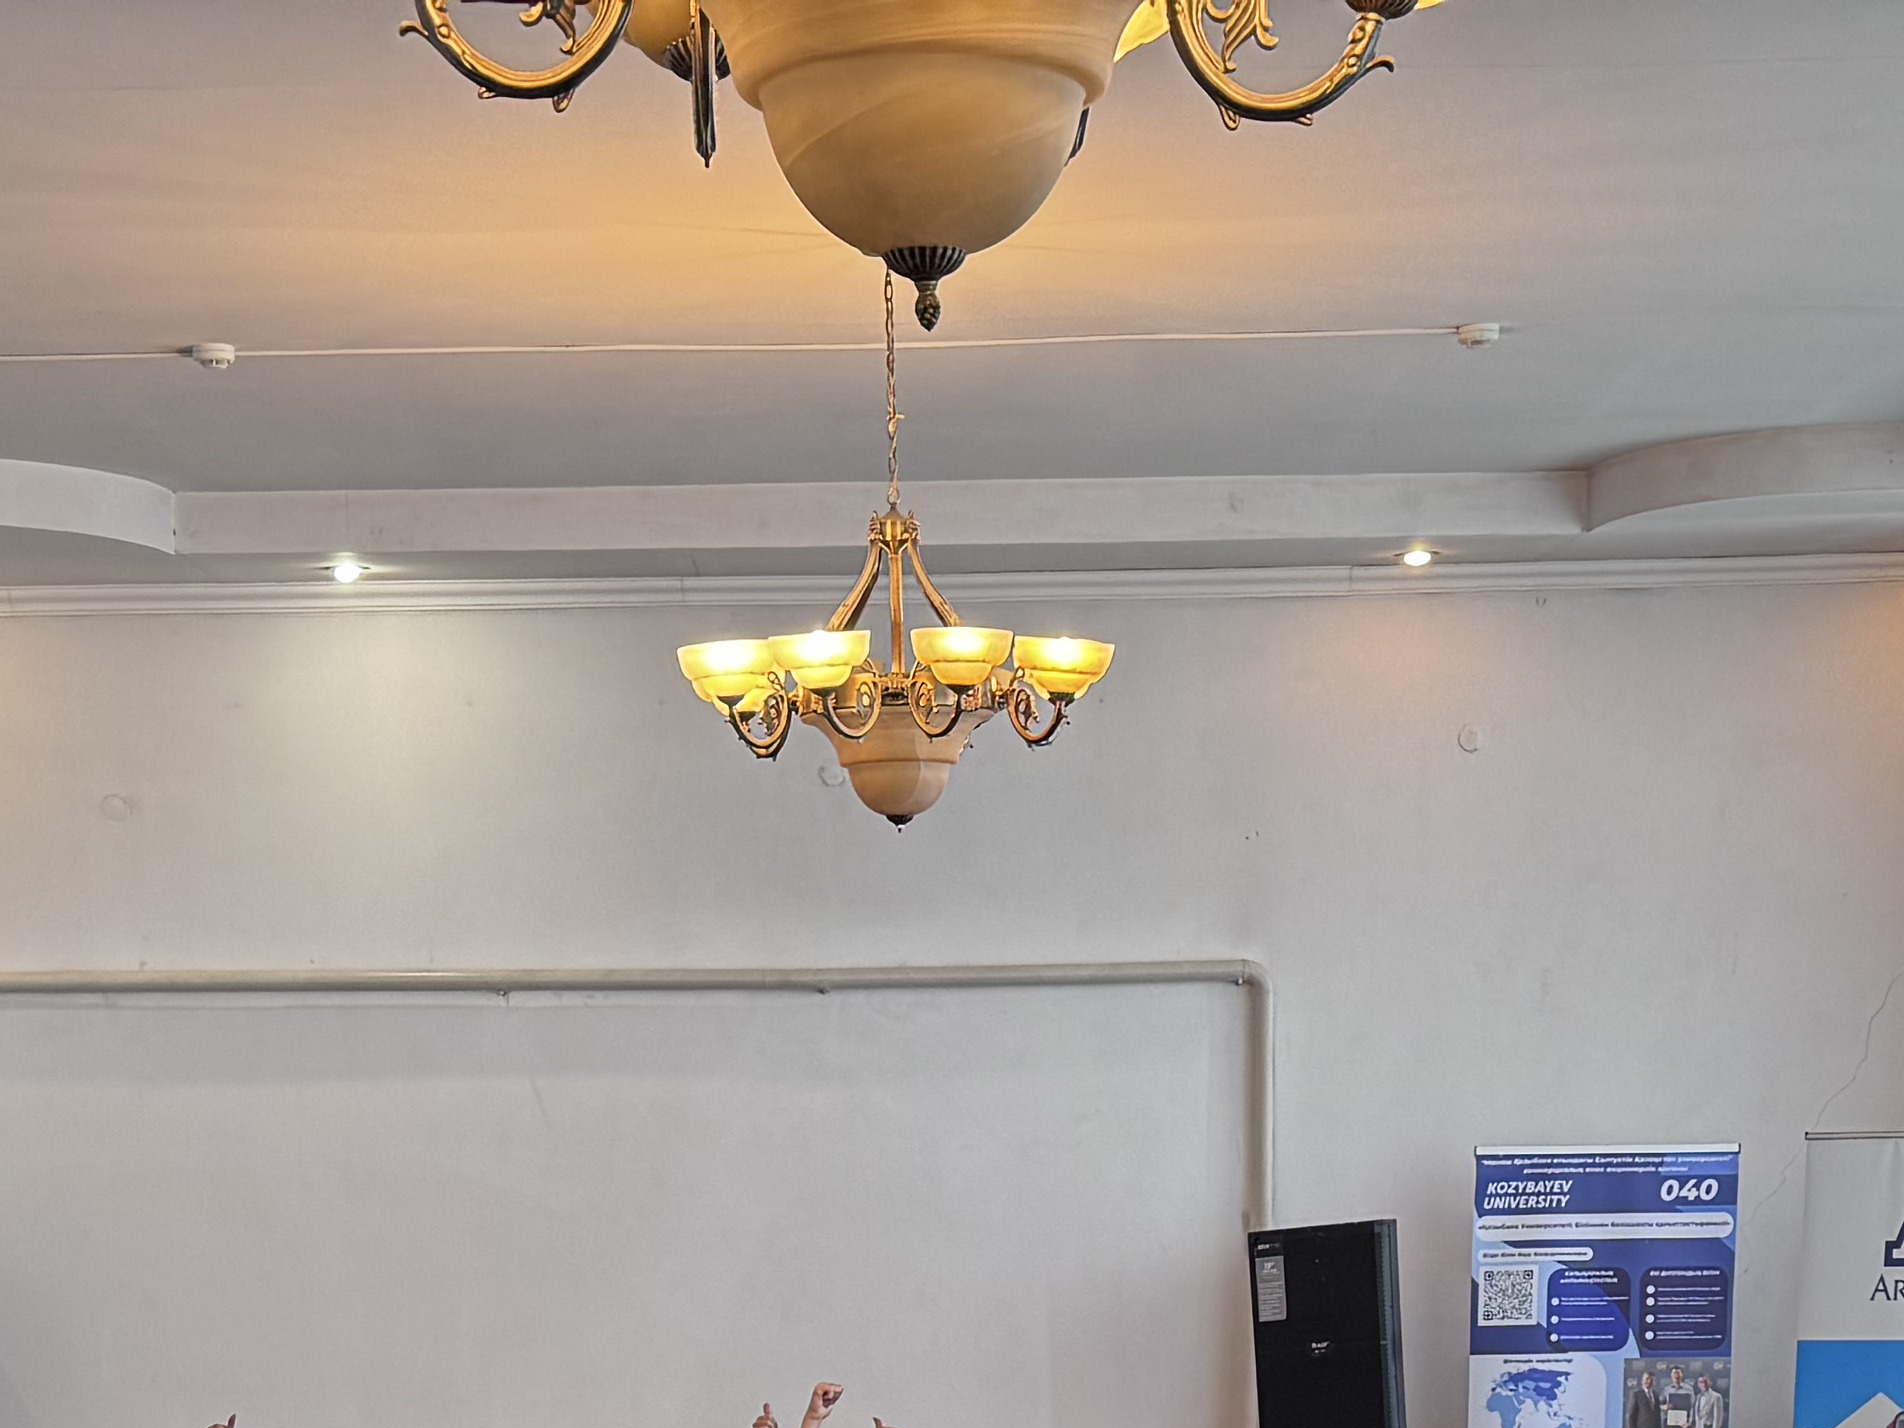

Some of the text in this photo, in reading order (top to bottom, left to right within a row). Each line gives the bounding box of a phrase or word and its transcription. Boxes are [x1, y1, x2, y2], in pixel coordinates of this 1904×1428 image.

[1486, 1179, 1573, 1195] KOZYBAYEV
[1660, 1178, 1719, 1201] 040
[1483, 1194, 1569, 1209] UNIVERSITY
